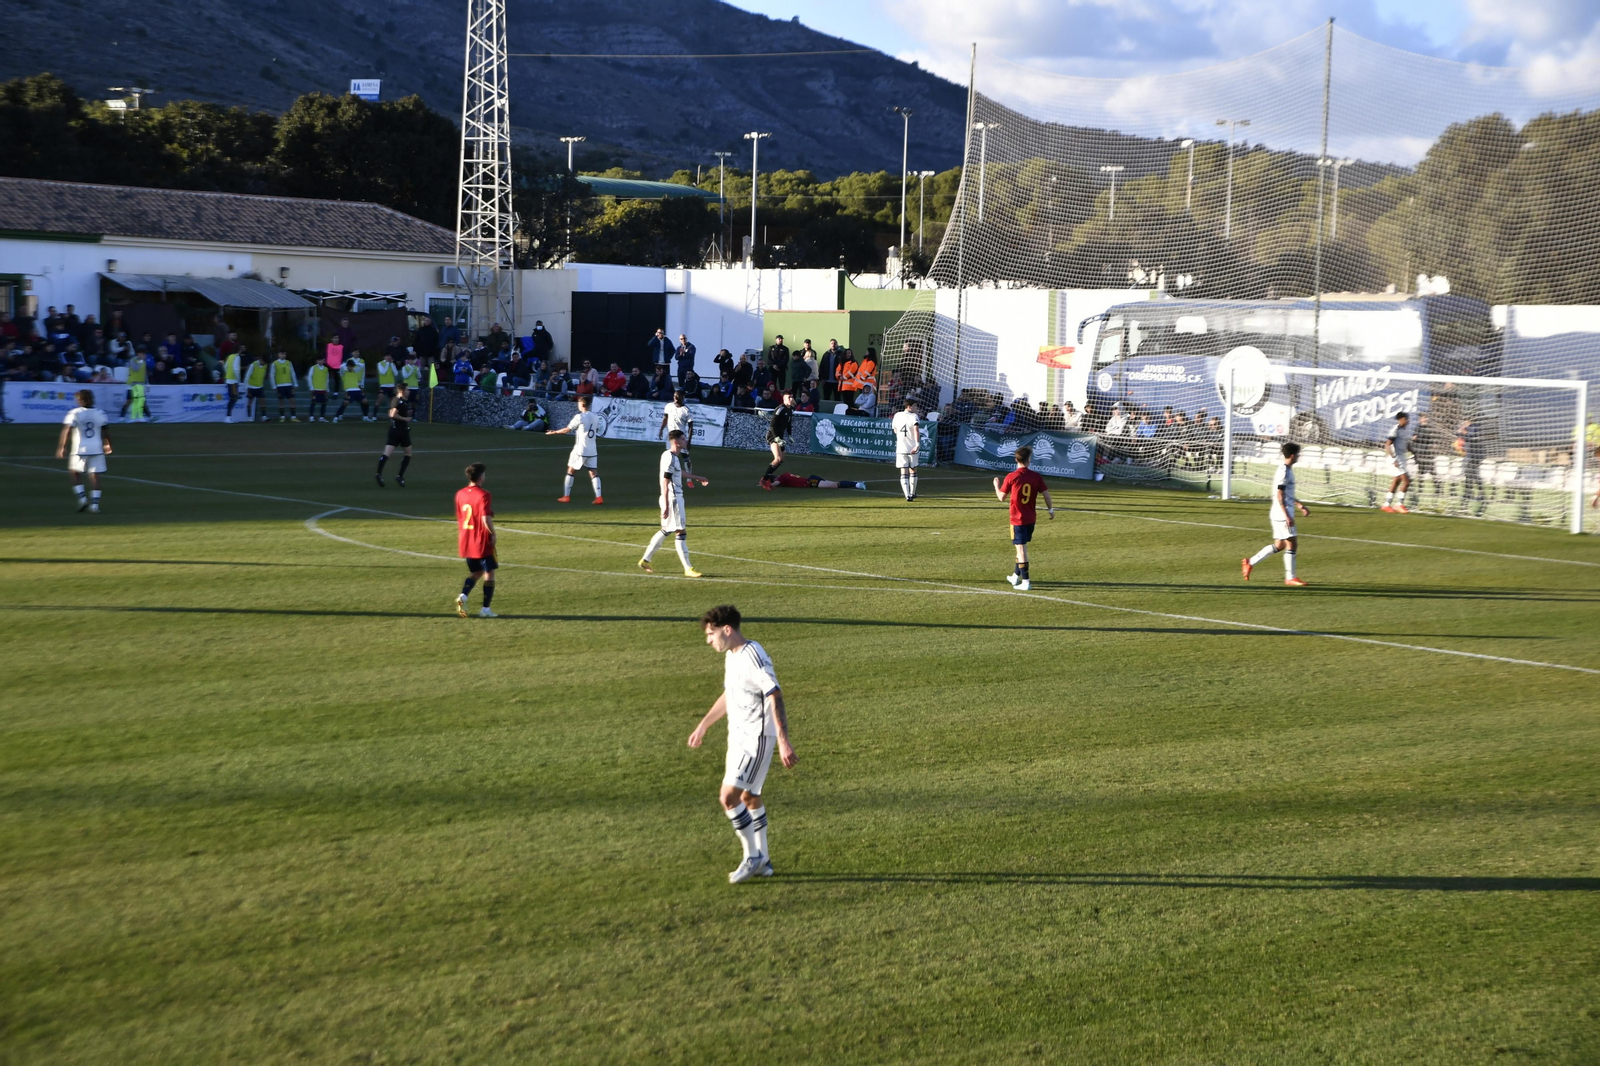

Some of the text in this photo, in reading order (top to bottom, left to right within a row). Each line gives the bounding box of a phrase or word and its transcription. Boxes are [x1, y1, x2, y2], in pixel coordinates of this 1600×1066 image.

[1142, 364, 1185, 374] JUVENTUD
[1334, 388, 1419, 430] VERDES!
[84, 421, 95, 439] 8
[587, 423, 595, 439] 6
[840, 419, 868, 428] PESCADOS
[875, 422, 893, 430] MARI
[899, 423, 908, 437] 4
[1021, 483, 1031, 504] 9
[462, 504, 474, 529] 2
